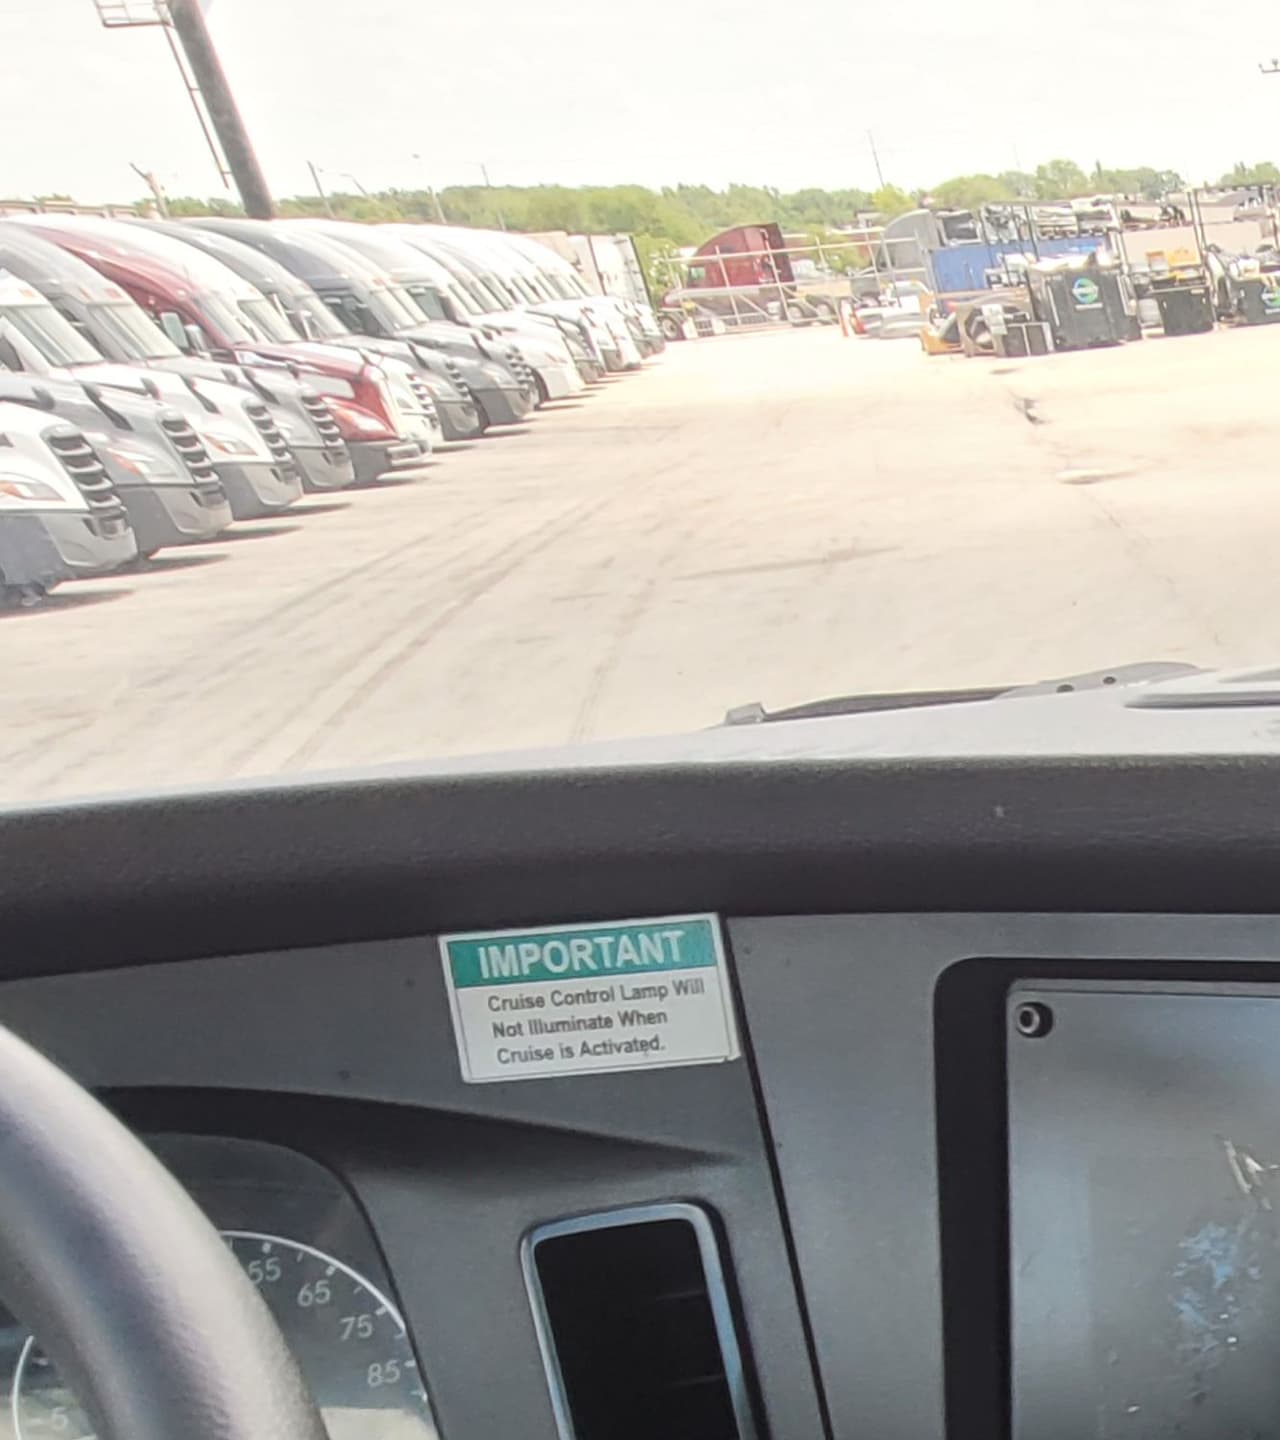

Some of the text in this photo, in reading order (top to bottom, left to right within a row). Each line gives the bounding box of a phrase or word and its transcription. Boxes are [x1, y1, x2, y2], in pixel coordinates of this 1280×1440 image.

[477, 929, 686, 979] IMPORTANT
[487, 976, 705, 1012] Cruise Control Lamp Will
[491, 1008, 668, 1039] Not Illuminate When
[496, 1034, 665, 1065] Cruise is Activated.
[248, 1256, 282, 1286] 55
[297, 1279, 331, 1308] 65
[339, 1314, 374, 1341] 75
[367, 1359, 401, 1388] 85
